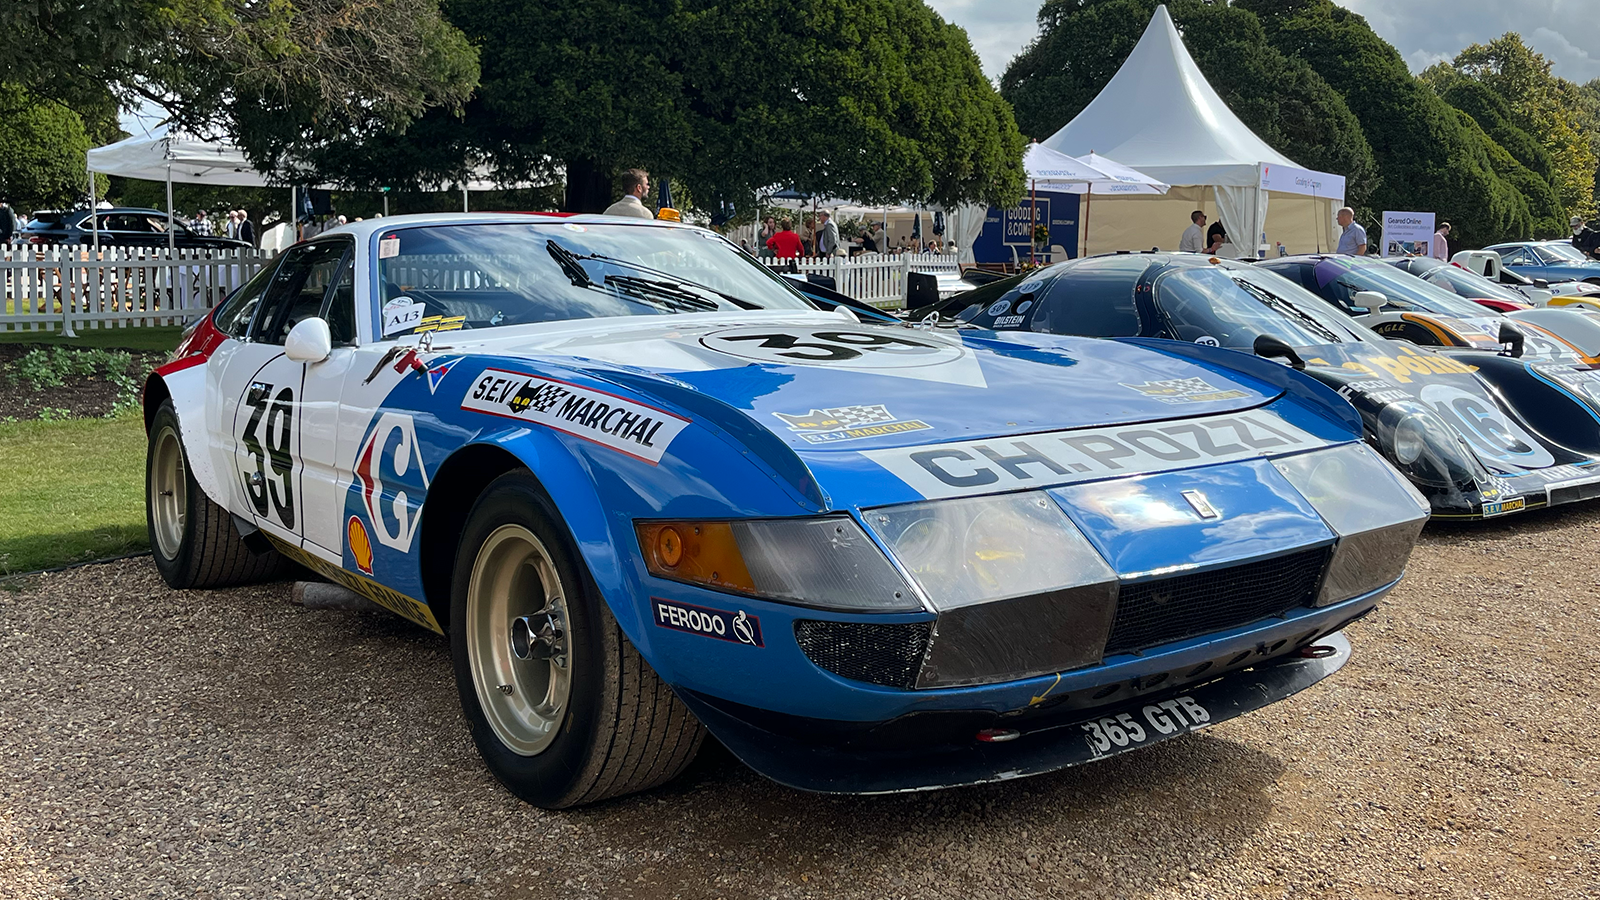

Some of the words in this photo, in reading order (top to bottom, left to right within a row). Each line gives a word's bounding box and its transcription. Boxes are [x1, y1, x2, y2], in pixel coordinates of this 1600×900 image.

[1406, 217, 1422, 225] Online
[1022, 282, 1040, 291] 379
[990, 303, 1008, 313] 509
[994, 315, 1025, 324] BILSTEIN
[719, 331, 941, 361] 39
[1366, 346, 1480, 383] point
[1365, 389, 1415, 404] TOTAL
[556, 394, 664, 448] MARCHAL
[845, 420, 927, 438] MARCHAL
[1429, 397, 1535, 459] 16
[242, 381, 294, 530] 39
[909, 415, 1303, 488] CH.POZZI
[1501, 499, 1524, 512] MARCHAL
[365, 581, 434, 629] FRANCE
[657, 603, 726, 636] FERODO
[1083, 713, 1147, 752] 365
[1142, 696, 1211, 735] GTB
